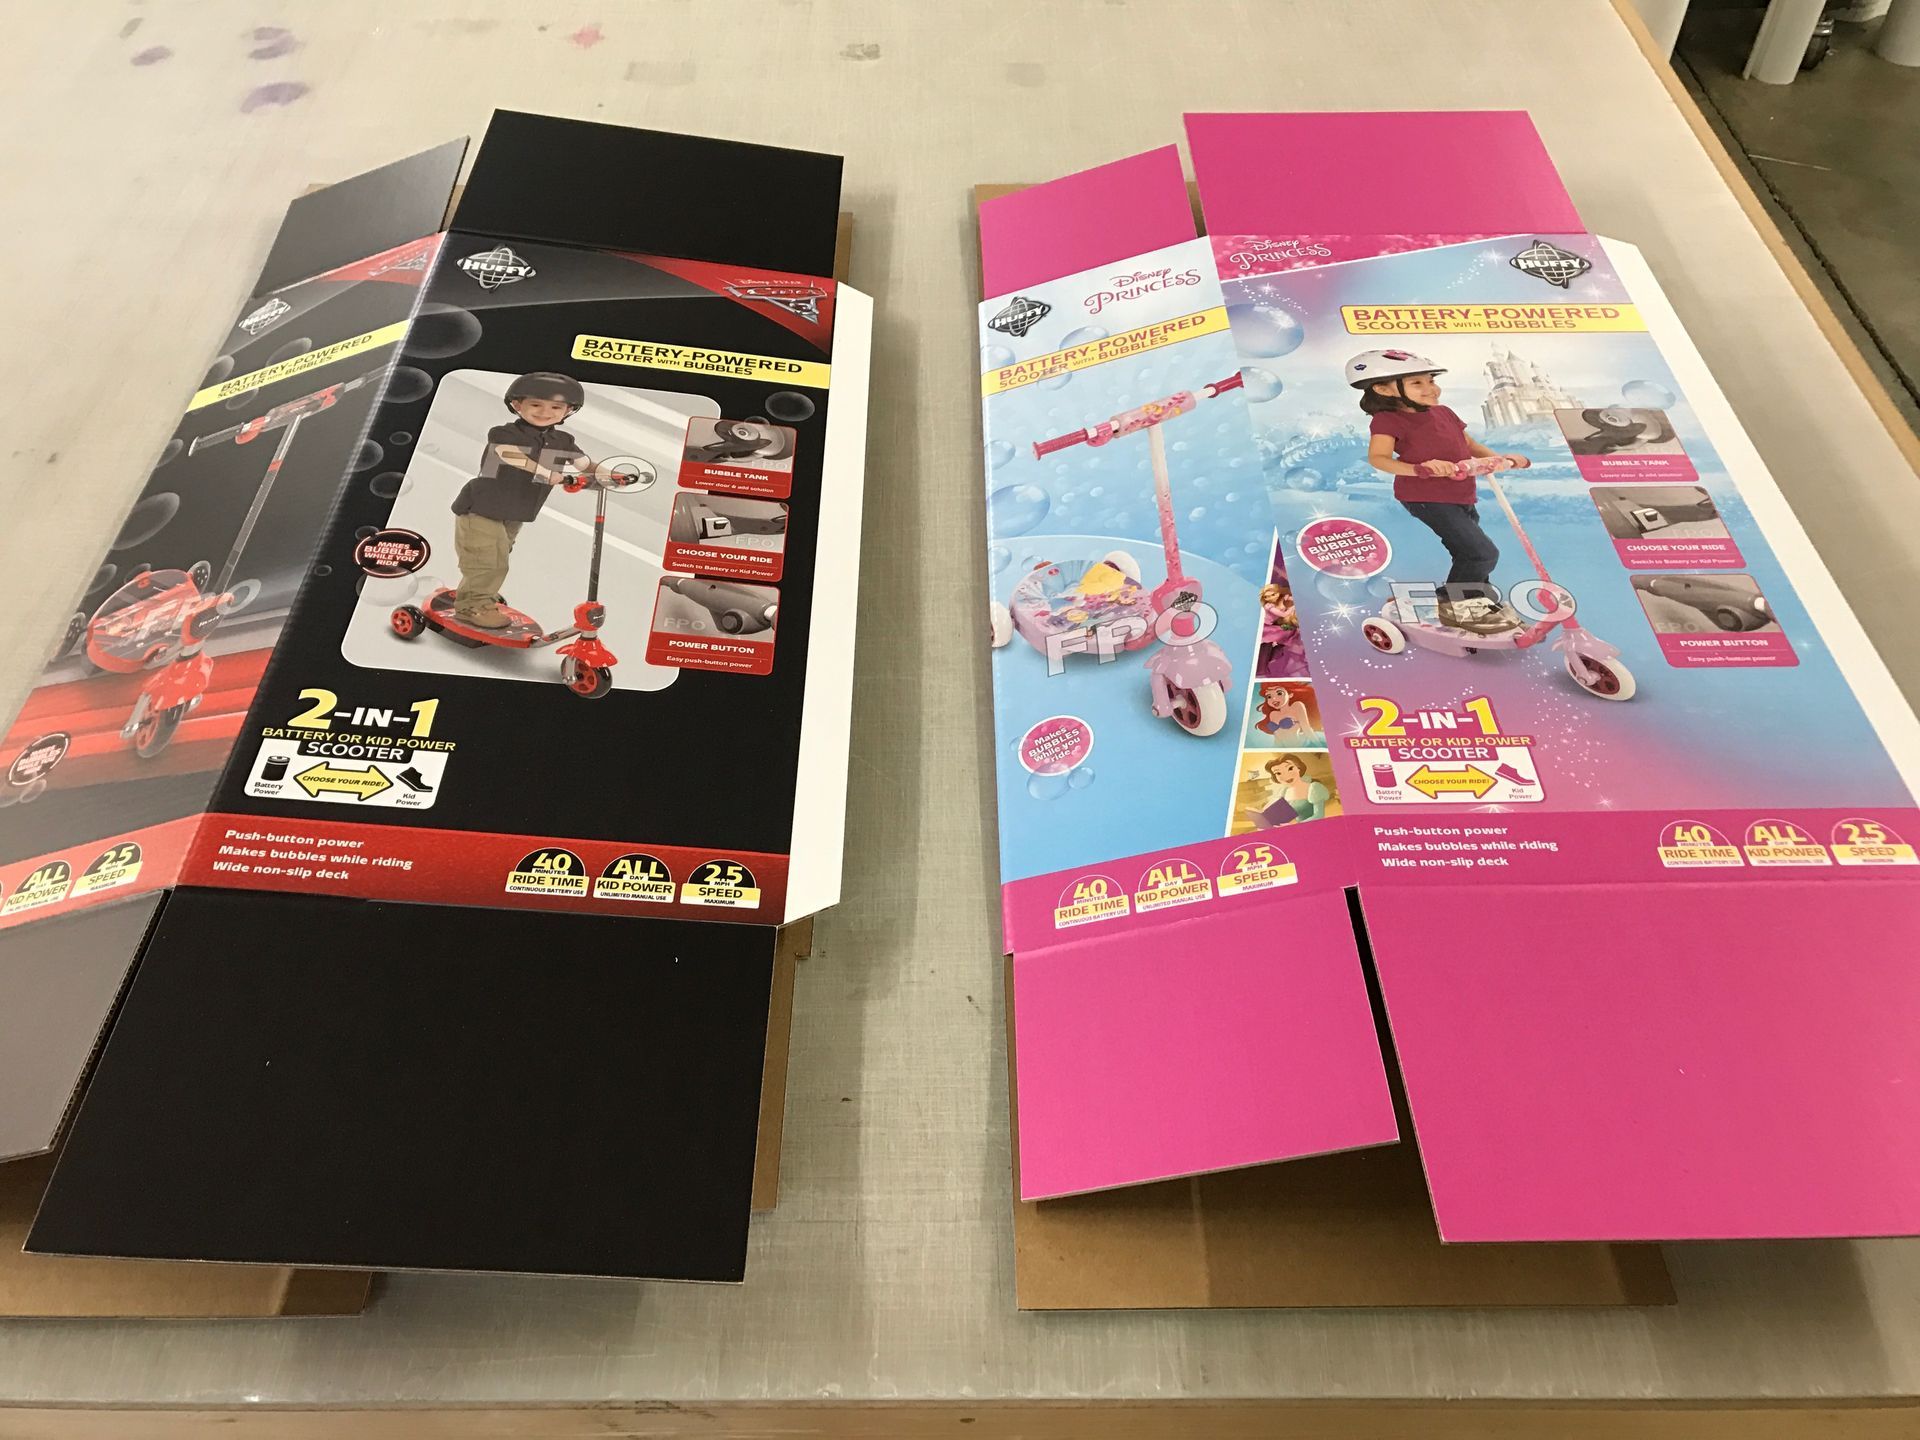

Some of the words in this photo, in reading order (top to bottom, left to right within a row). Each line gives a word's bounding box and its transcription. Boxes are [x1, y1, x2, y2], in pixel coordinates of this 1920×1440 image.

[1230, 243, 1332, 270] PRINCESS
[1517, 258, 1580, 270] HUFFY
[462, 258, 531, 276] HUFFY
[1083, 269, 1202, 314] PRINCESS
[994, 305, 1044, 329] HUFFY
[1353, 308, 1620, 321] BATTERY-POWERED
[1356, 320, 1446, 330] SCOOTER
[1487, 319, 1577, 329] BUBBLES
[1000, 315, 1206, 380] BATTERY-POWERED
[221, 335, 373, 392] BATTERY-POWERED
[581, 350, 653, 363] SCOOTER
[657, 358, 680, 366] WITH
[684, 361, 753, 376] BUBBLES
[584, 339, 802, 374] BATTERY-POWERED
[999, 363, 1068, 388] SCOOTER
[1098, 335, 1168, 360] BUBBLES
[217, 378, 265, 399] SCOOTER
[284, 355, 332, 375] BUBBLES
[704, 469, 741, 478] BUBBLE
[743, 473, 769, 481] TANK
[1308, 534, 1374, 555] BUBBLES
[1314, 530, 1357, 544] Makes
[364, 545, 420, 557] BUBBLES
[377, 541, 410, 550] MAKES
[1317, 550, 1352, 562] while
[1353, 544, 1377, 555] you
[364, 552, 393, 560] WHILE
[676, 548, 718, 558] CHOOSE
[720, 553, 748, 561] YOUR
[749, 556, 773, 564] RIDE
[1340, 555, 1367, 566] ride
[672, 561, 694, 569] Switch
[704, 565, 729, 573] Battery
[752, 569, 774, 577] Power
[669, 640, 708, 650] POWER
[710, 645, 755, 654] BUTTON
[1045, 601, 1218, 677] FPO
[666, 655, 684, 663] Easy
[684, 657, 728, 667] push-button
[287, 688, 439, 738] 2-IN-1
[1359, 697, 1500, 736] 2-IN-1
[261, 727, 335, 741] BATTERY
[338, 733, 361, 743] OR
[365, 736, 393, 746] KID
[396, 738, 456, 751] POWER
[1028, 728, 1080, 757] BUBBLES
[1034, 727, 1067, 746] Makes
[1350, 738, 1416, 748] BATTERY
[1420, 738, 1441, 747] OR
[1446, 737, 1471, 747] KID
[1475, 736, 1531, 746] POWER
[306, 742, 405, 761] SCOOTER
[1033, 746, 1060, 762] while
[1062, 737, 1080, 750] you
[1051, 749, 1070, 762] ride
[1398, 747, 1490, 760] SCOOTER
[254, 782, 284, 791] Battery
[302, 775, 335, 784] CHOOSE
[253, 788, 280, 796] Power
[225, 829, 314, 845] Push-button
[317, 838, 364, 849] power
[1374, 827, 1460, 837] Push-button
[1464, 827, 1508, 837] power
[1675, 825, 1711, 842] 40
[1754, 826, 1807, 842] ALL
[1378, 842, 1422, 851] Makes
[1425, 841, 1478, 851] bubbles
[1481, 841, 1516, 850] while
[1519, 841, 1559, 852] riding
[1664, 849, 1697, 858] RIDE
[1700, 848, 1735, 857] TIME
[1747, 848, 1770, 857] KID
[1773, 848, 1825, 857] POWER
[1850, 847, 1896, 856] SPEED
[218, 845, 266, 858] Makes
[270, 849, 326, 862] bubbles
[330, 853, 368, 865] while
[372, 857, 413, 870] riding
[533, 853, 572, 871] 40
[1382, 858, 1417, 867] Wide
[1420, 857, 1475, 868] non-slip
[1478, 857, 1509, 866] deck
[212, 861, 250, 873] Wide
[253, 866, 312, 879] non-slip
[316, 868, 349, 880] deck
[612, 859, 664, 878] ALL
[1147, 863, 1197, 886] ALL
[23, 865, 65, 890] ALL
[87, 869, 126, 885] SPEED
[513, 874, 546, 885] RIDE
[550, 877, 583, 888] TIME
[1234, 869, 1278, 885] SPEED
[6, 895, 25, 906] KID
[26, 883, 68, 902] POWER
[509, 885, 546, 893] CONTINUOUS
[597, 880, 619, 890] KID
[622, 882, 673, 894] POWER
[698, 887, 743, 898] SPEED
[1073, 879, 1107, 899] 40
[1137, 892, 1157, 903] KID
[1161, 882, 1208, 899] POWER
[1060, 905, 1089, 919] RIDE
[1093, 898, 1124, 912] TIME
